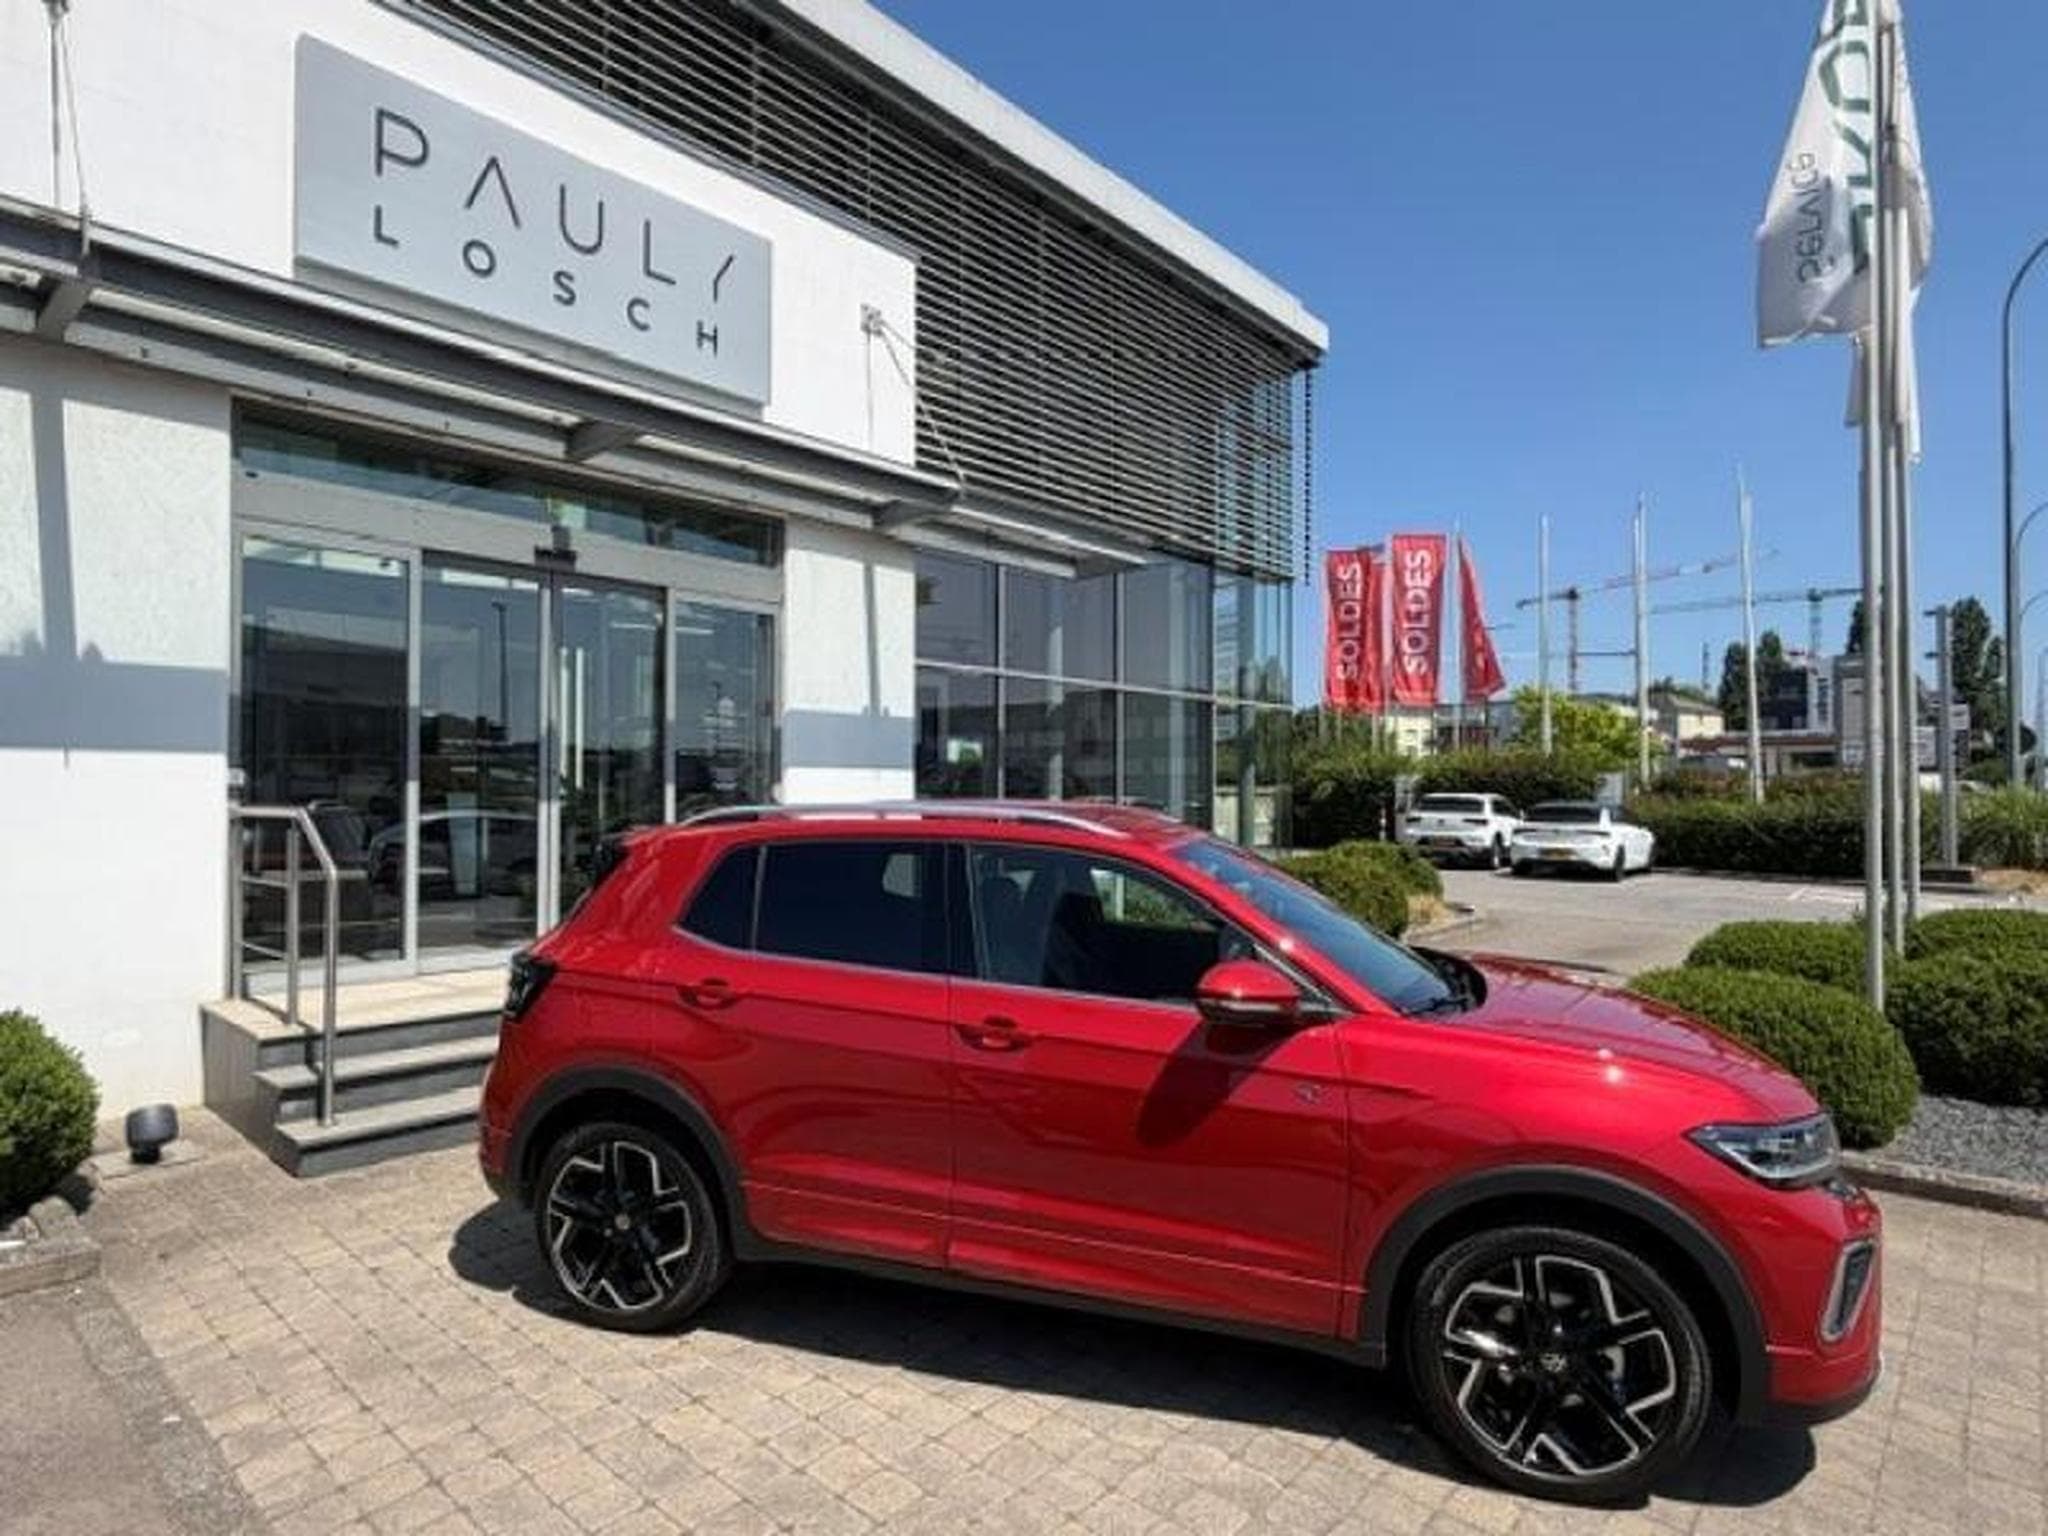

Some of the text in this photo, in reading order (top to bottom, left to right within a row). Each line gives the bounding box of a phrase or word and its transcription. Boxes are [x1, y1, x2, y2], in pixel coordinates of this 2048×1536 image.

[374, 107, 735, 302] PAULY
[374, 204, 719, 356] LOSCH
[1336, 561, 1363, 681] SOLDES
[1400, 549, 1432, 676] SOLDES
